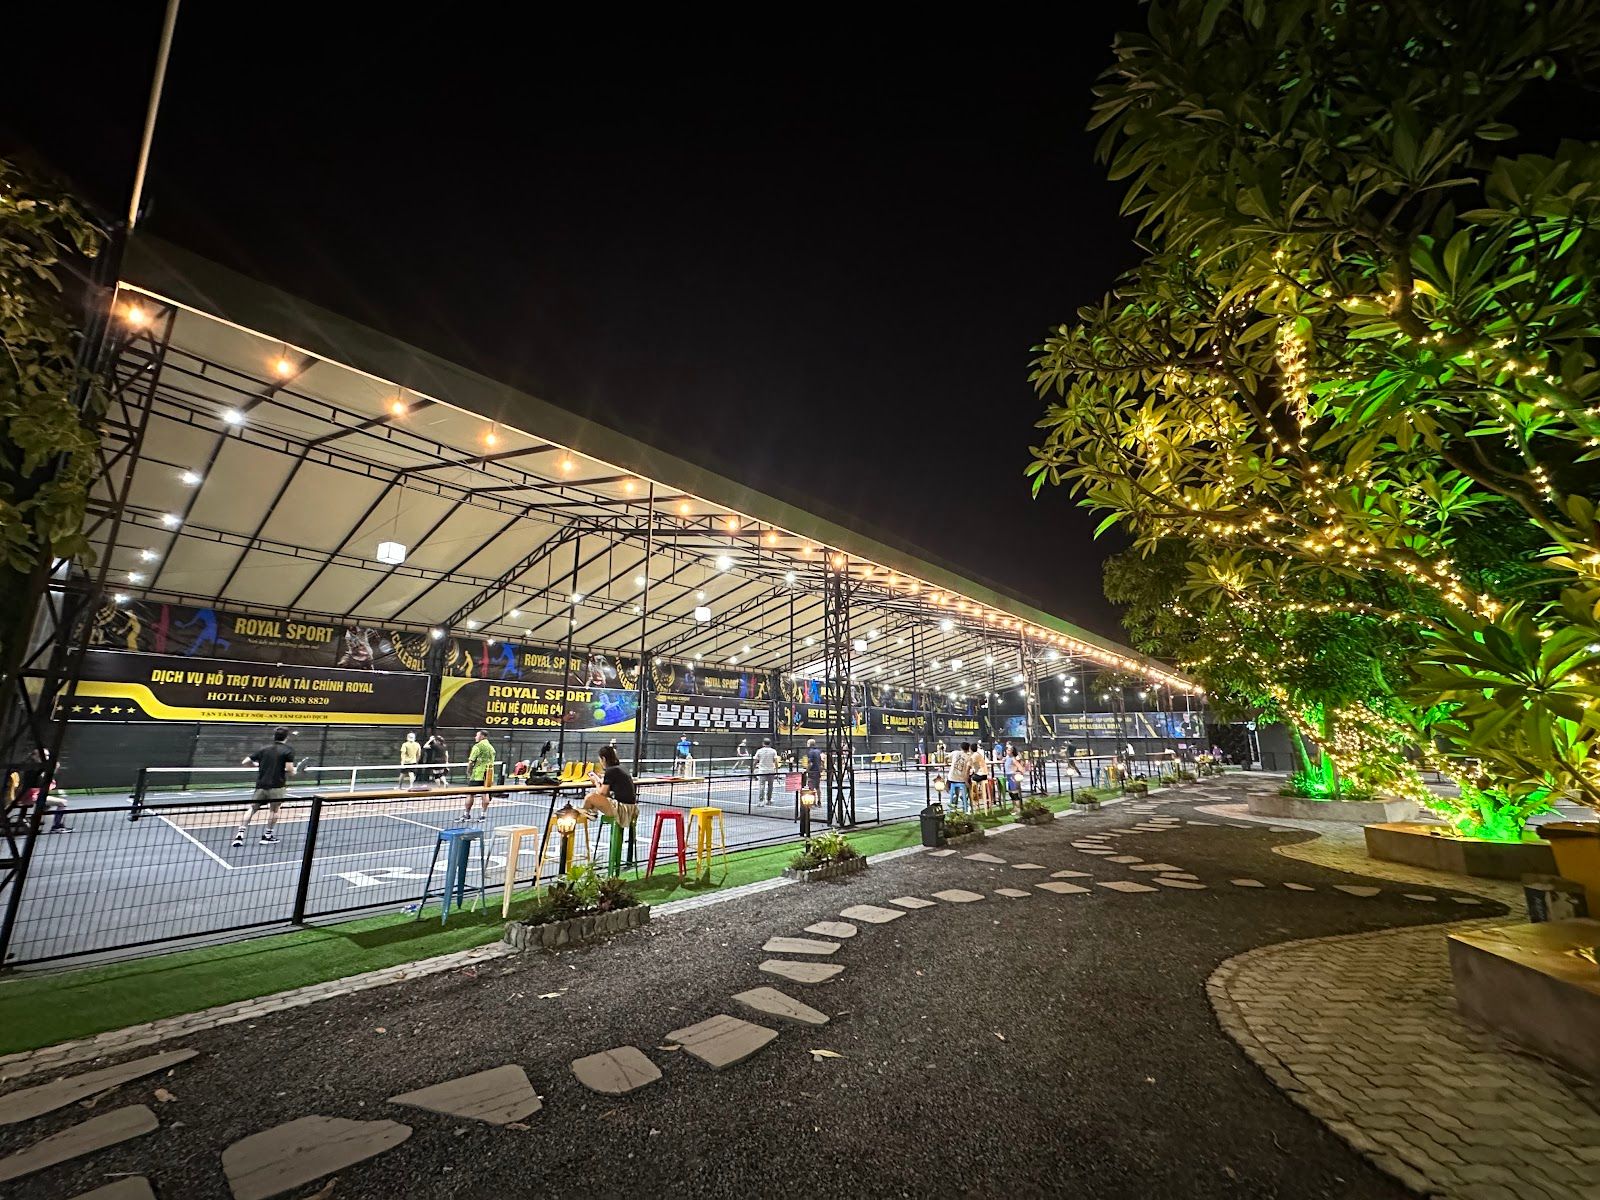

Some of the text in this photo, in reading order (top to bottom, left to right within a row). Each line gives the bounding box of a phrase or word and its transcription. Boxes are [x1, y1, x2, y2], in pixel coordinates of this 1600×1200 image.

[234, 617, 334, 643] ROYAL SPORT
[524, 653, 582, 671] ROYAL SPRT
[151, 669, 374, 693] DỊCH VỤ HỖ TRỢ TƯ VẤN TÀI CHÍNH ROYAL
[206, 691, 330, 705] HOTLINE: 090 388 8820
[488, 685, 593, 703] ROYAL SPORT
[486, 699, 507, 713] LIÊN
[507, 700, 520, 716] HỆ
[521, 700, 549, 715] QUẢNG
[485, 715, 509, 725] 092
[511, 717, 534, 726] 848
